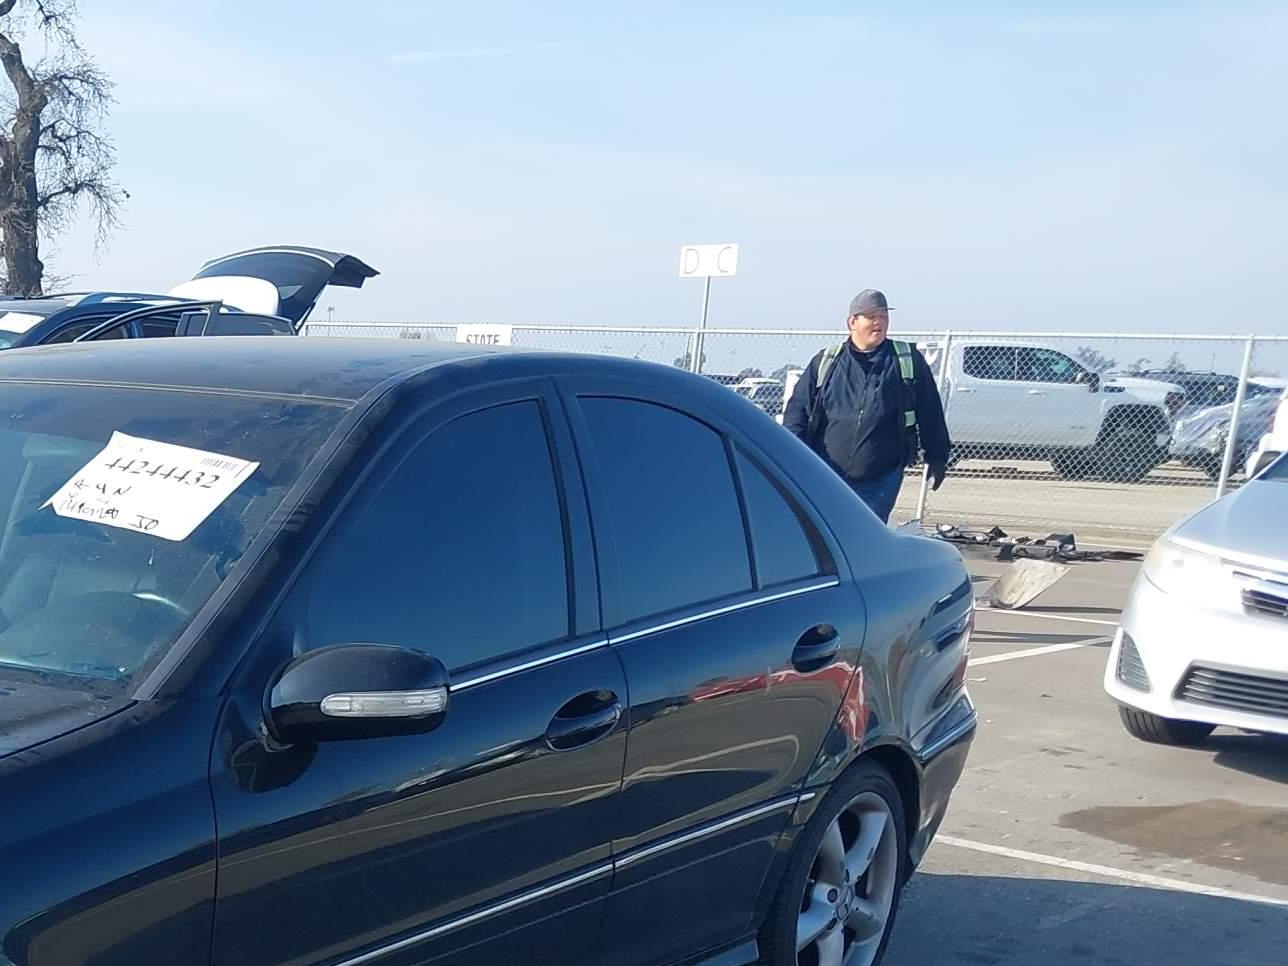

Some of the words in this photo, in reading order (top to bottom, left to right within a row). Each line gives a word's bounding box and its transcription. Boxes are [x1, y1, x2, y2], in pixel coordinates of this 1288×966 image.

[684, 248, 700, 274] D
[717, 246, 733, 273] C
[105, 457, 220, 488] 44244432
